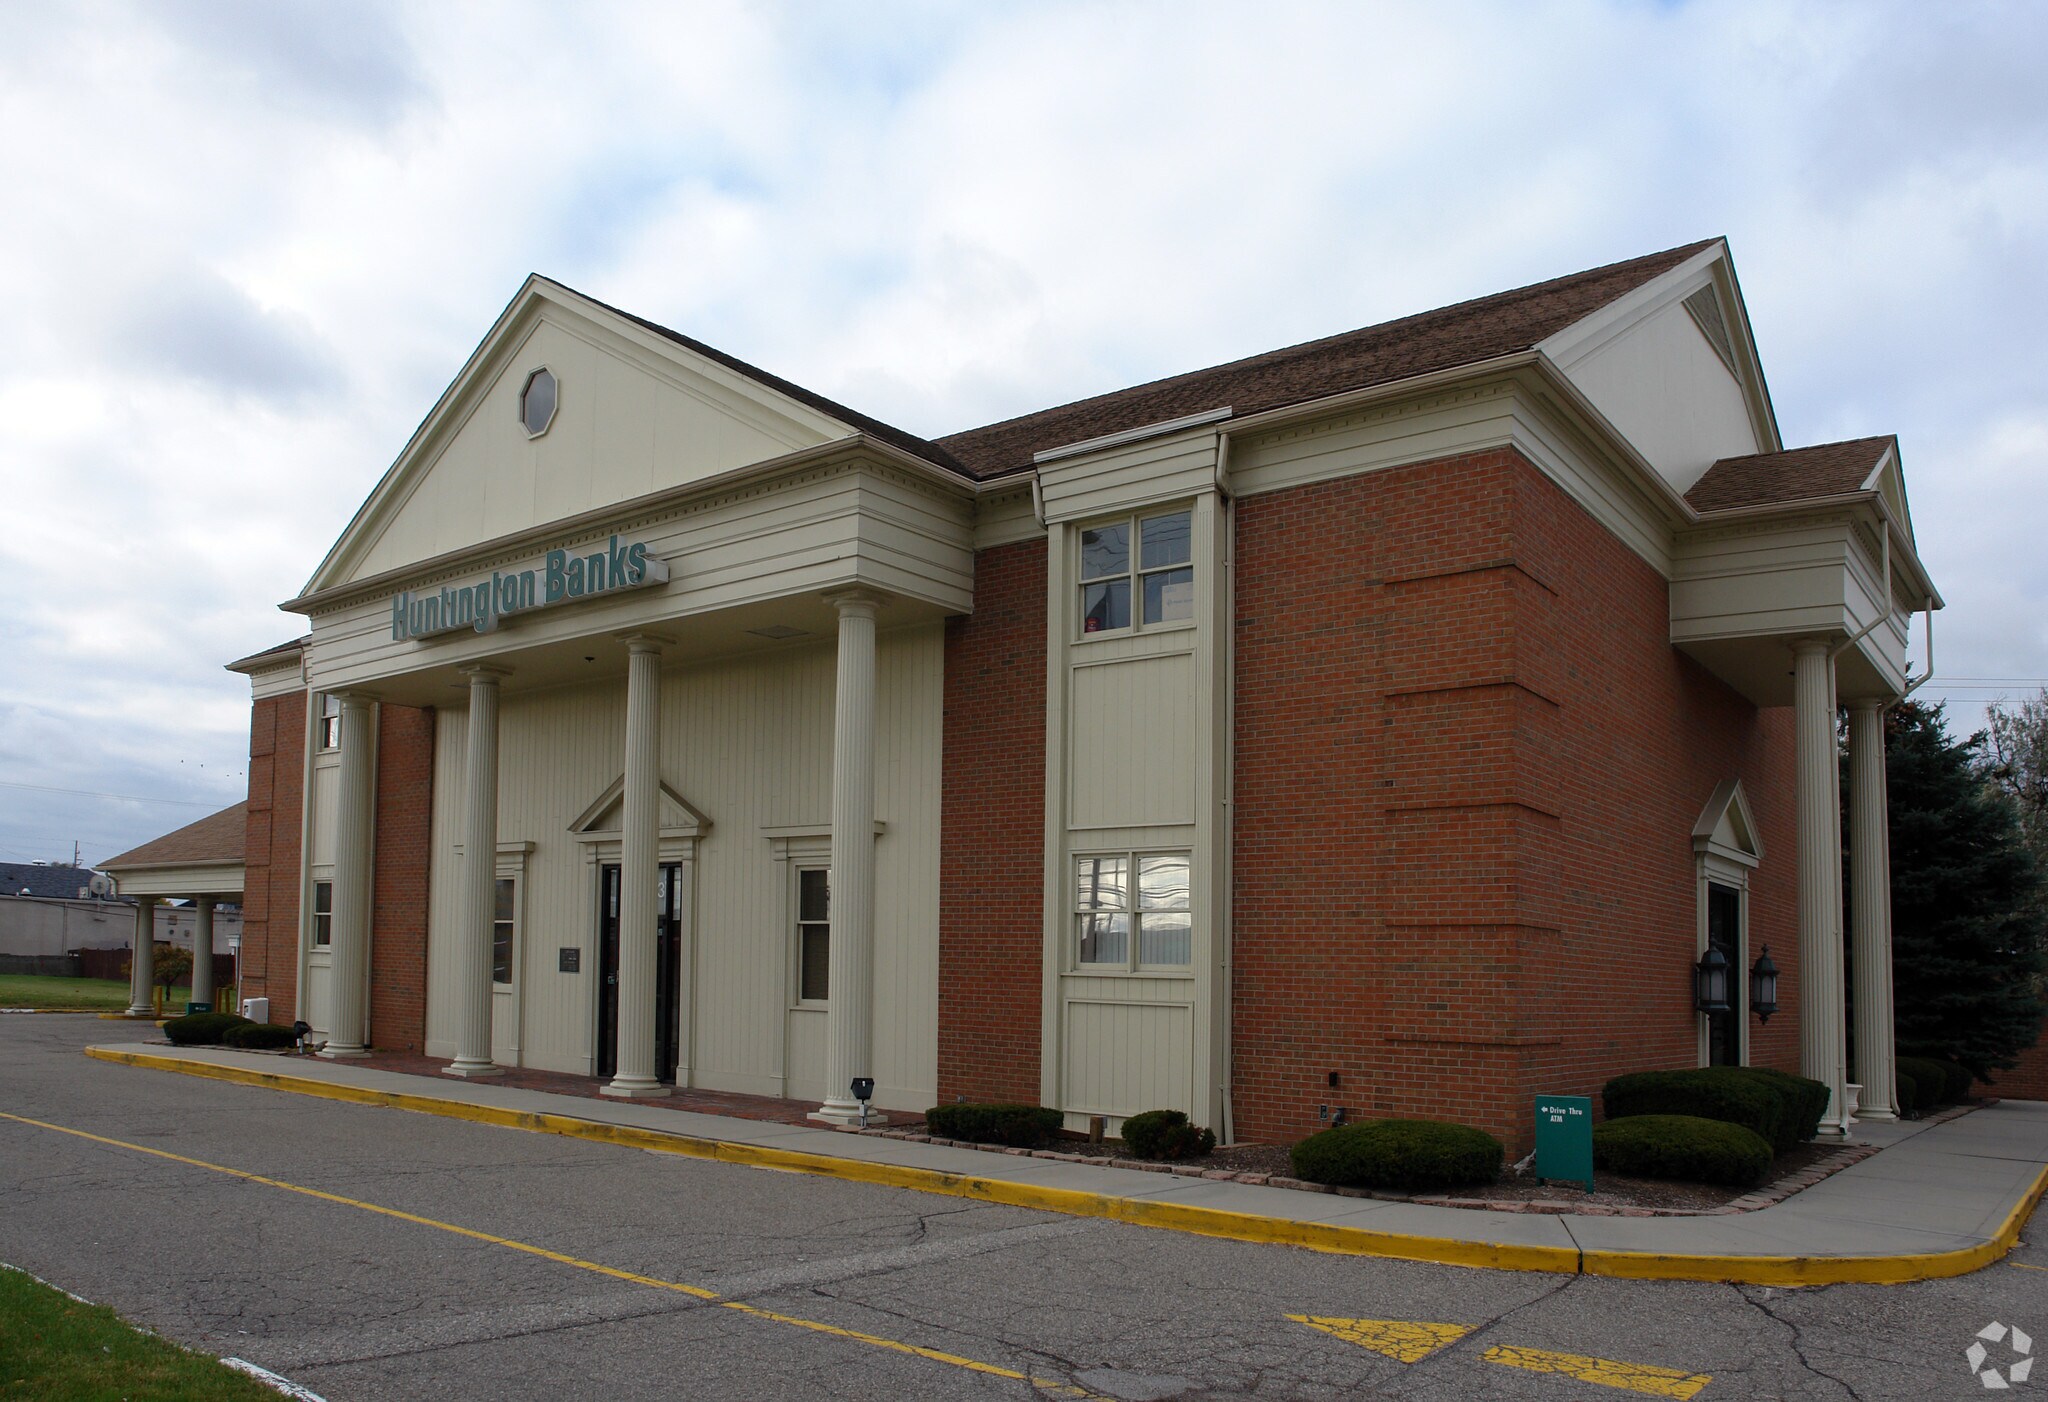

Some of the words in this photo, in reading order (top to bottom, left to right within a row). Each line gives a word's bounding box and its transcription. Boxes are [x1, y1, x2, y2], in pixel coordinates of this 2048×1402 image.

[392, 569, 538, 641] Huntington
[545, 534, 648, 603] Banks
[1549, 1106, 1566, 1115] Drive
[1568, 1107, 1583, 1116] Thru
[1550, 1115, 1563, 1123] ATM
